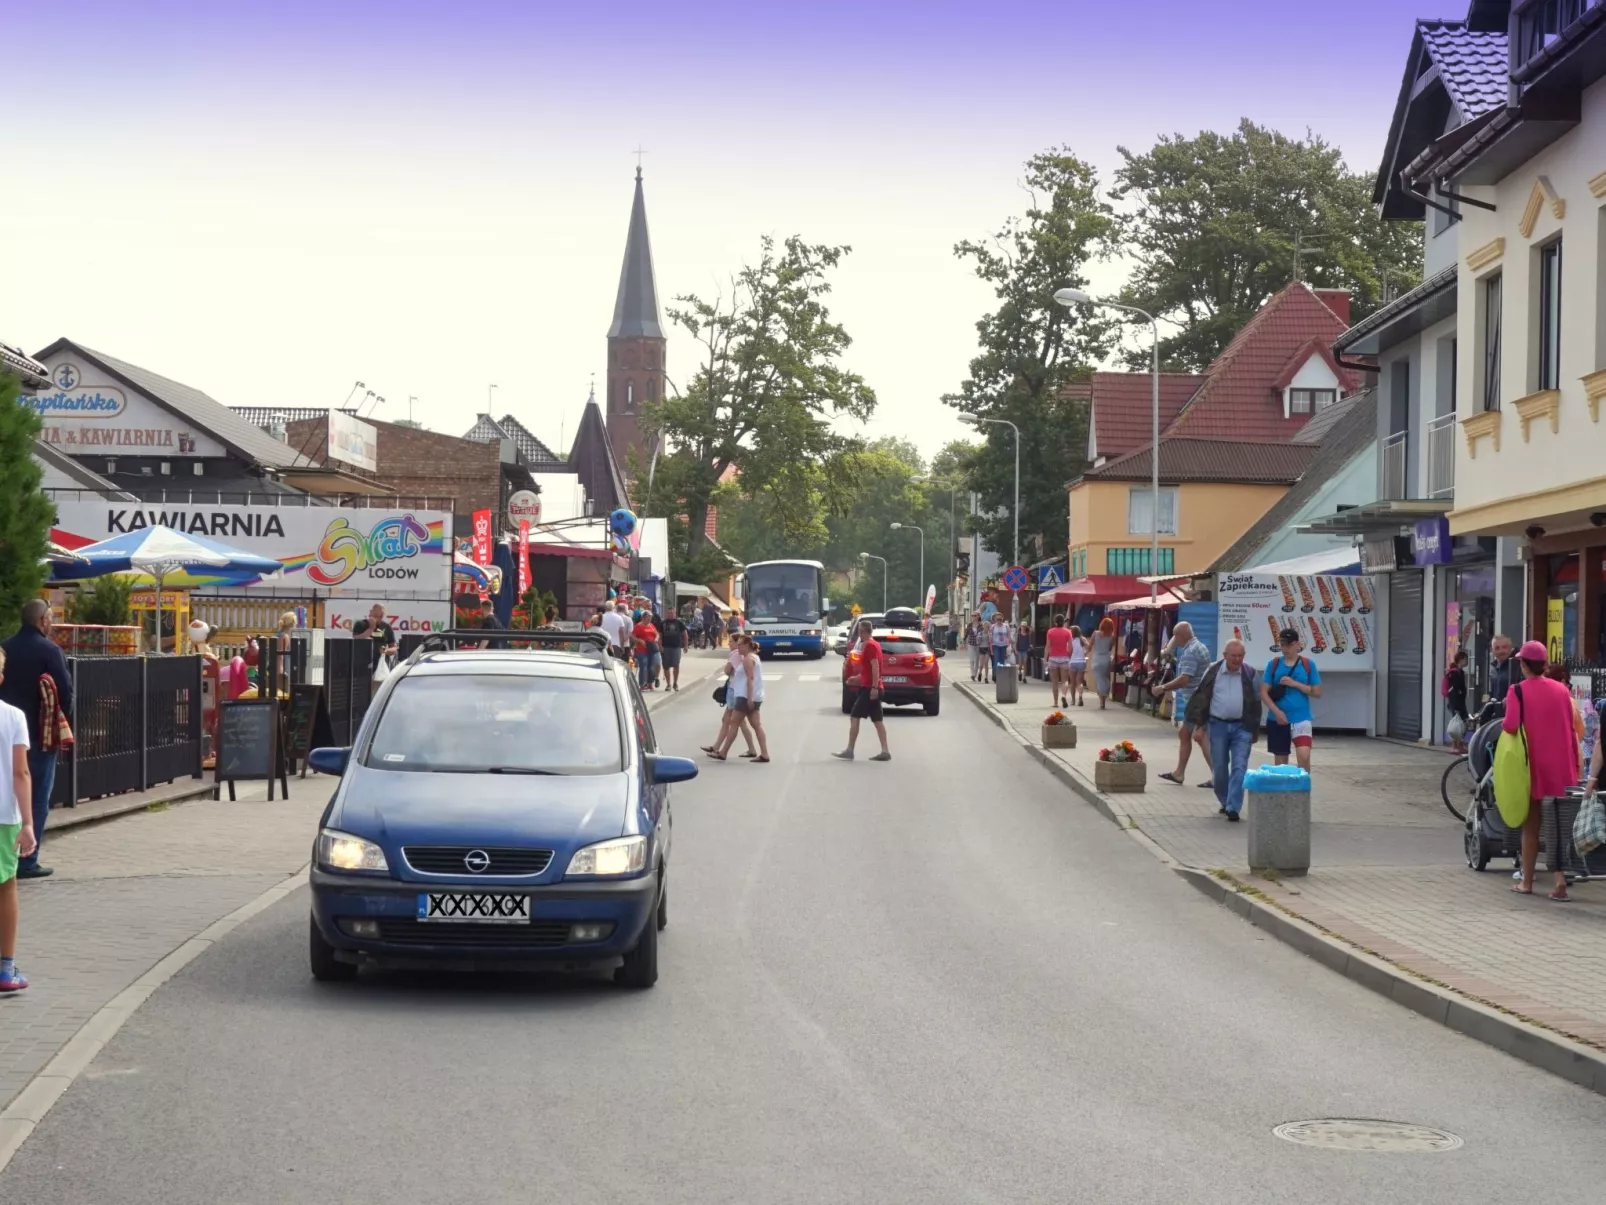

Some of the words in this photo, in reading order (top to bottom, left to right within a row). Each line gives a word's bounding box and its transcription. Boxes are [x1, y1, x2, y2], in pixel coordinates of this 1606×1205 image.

[66, 430, 76, 443] &
[80, 428, 173, 447] KAWIARNIA
[108, 509, 285, 538] KAWIARNIA
[369, 566, 419, 579] LODÓW
[1219, 581, 1278, 592] Zapiekanek
[386, 615, 445, 631] Zabaw
